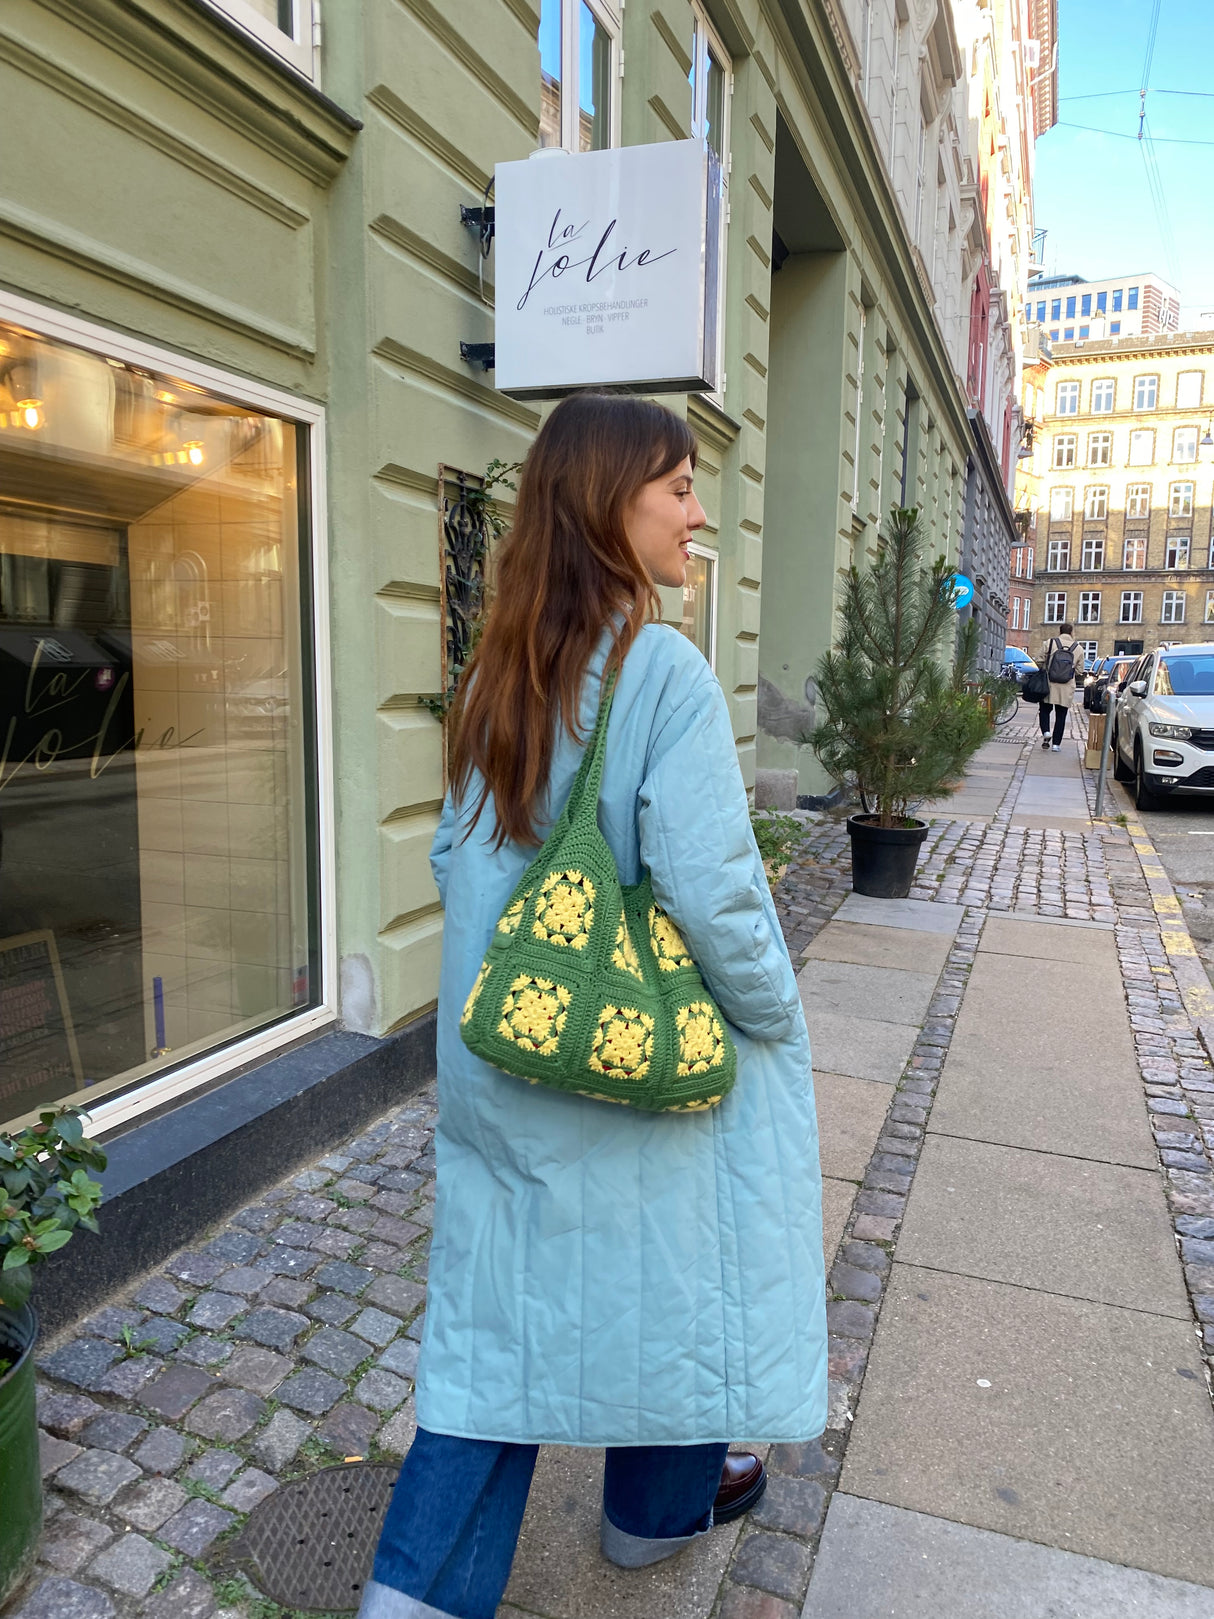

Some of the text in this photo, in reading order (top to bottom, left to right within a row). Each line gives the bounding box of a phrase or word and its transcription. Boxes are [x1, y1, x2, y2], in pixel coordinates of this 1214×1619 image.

[548, 208, 590, 250] la
[579, 298, 648, 312] KROPSBEHANDLINGER
[562, 316, 582, 326] NEGLE
